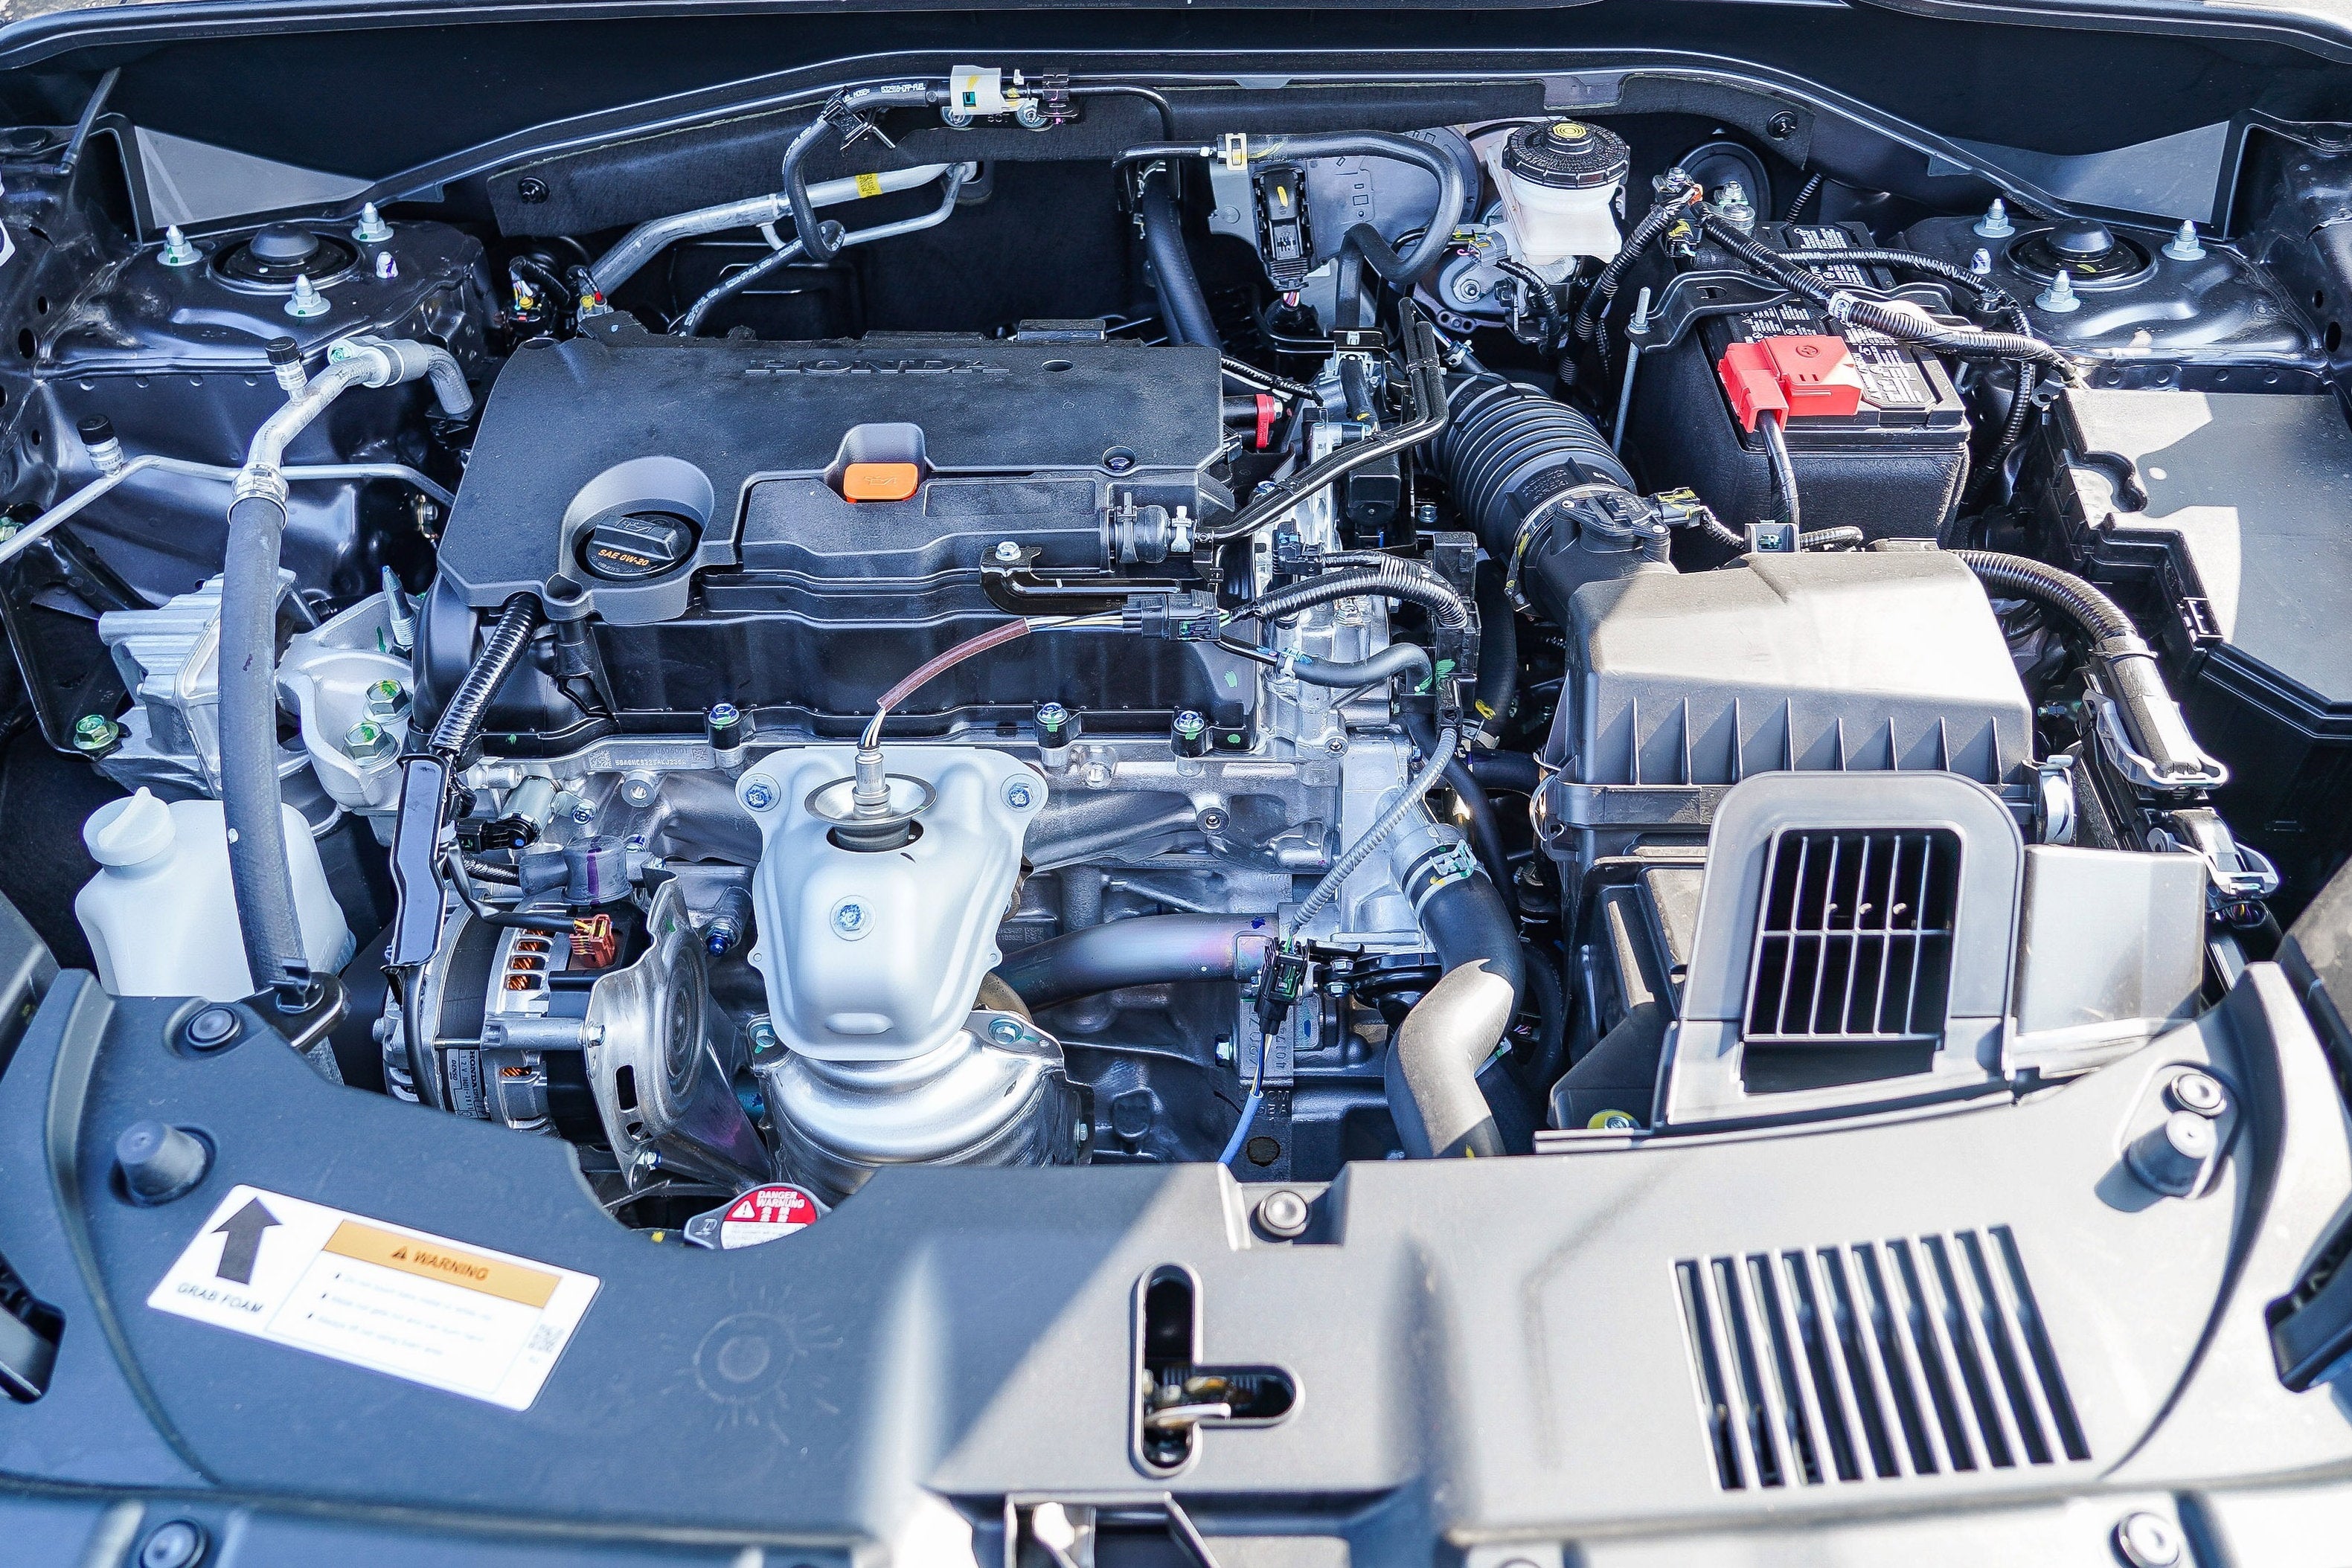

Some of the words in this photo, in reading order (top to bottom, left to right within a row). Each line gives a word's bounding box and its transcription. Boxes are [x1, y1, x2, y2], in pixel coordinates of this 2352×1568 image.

[745, 359, 1010, 374] HONDA
[597, 548, 621, 559] SAE
[620, 554, 650, 567] 0W-20
[469, 1050, 478, 1089] HONDA
[757, 1190, 798, 1199] DANGER
[413, 1250, 490, 1282] WARNING
[177, 1281, 219, 1302] GRAB
[221, 1293, 264, 1314] FOAM
